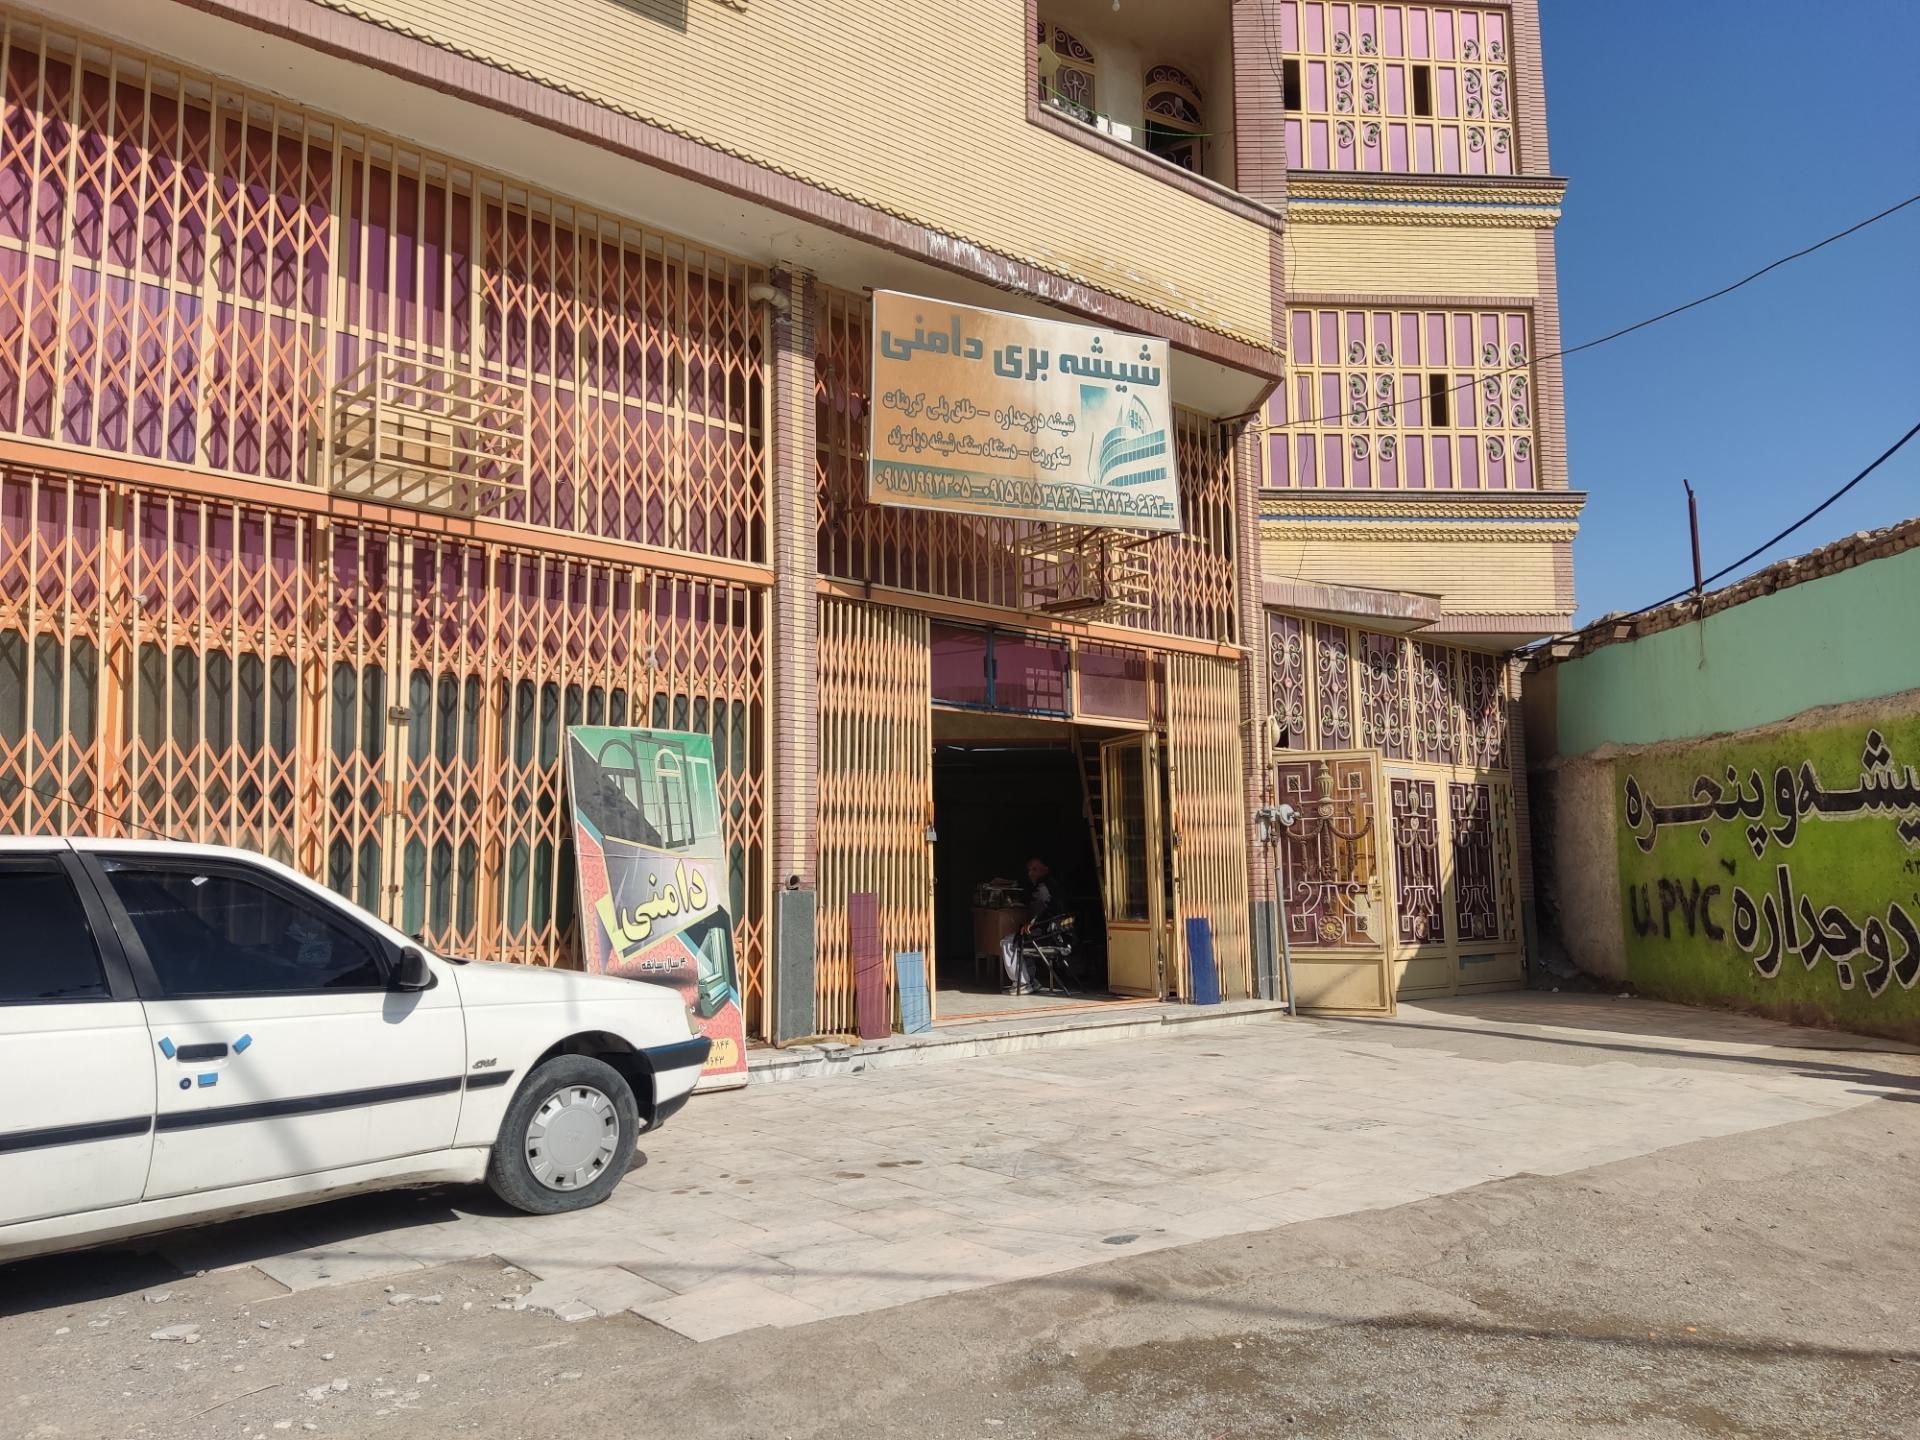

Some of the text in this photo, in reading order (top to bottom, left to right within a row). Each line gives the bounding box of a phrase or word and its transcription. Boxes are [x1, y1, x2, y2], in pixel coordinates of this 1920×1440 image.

[880, 314, 1161, 393] شیشه بری دامنی
[928, 431, 956, 456] شیشه
[1047, 412, 1076, 437] شیشه
[1624, 765, 1766, 860] پنجره
[1797, 729, 1920, 846] یشه
[620, 859, 709, 942] دامنی
